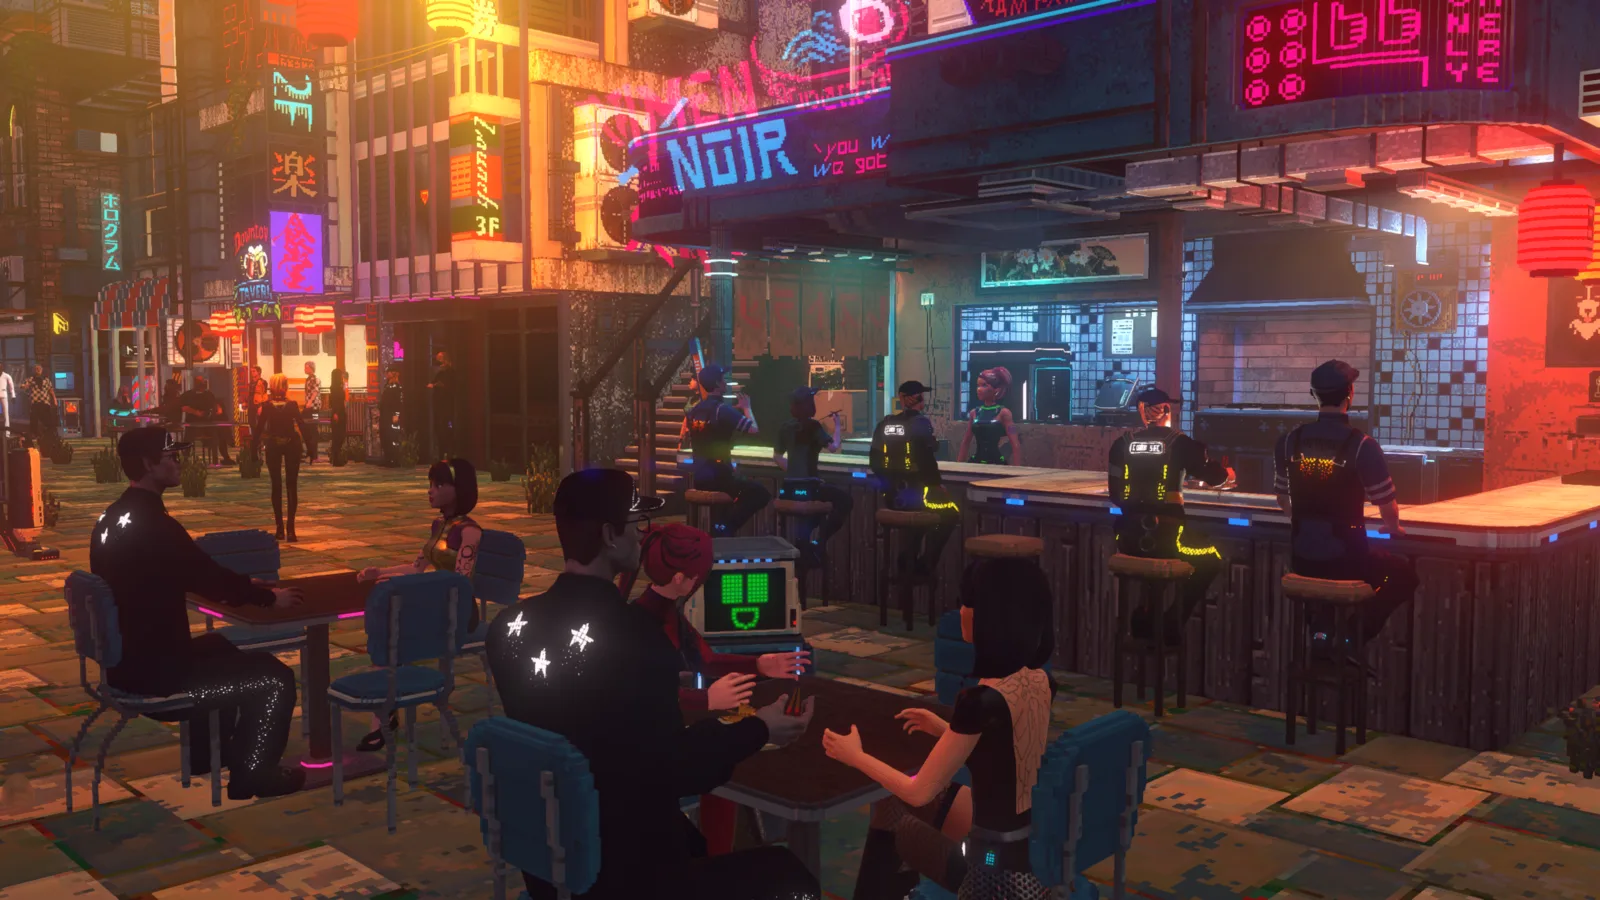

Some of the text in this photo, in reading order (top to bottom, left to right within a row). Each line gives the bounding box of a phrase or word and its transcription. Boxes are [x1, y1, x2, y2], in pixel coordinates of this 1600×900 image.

[1446, 0, 1470, 83] NLY
[1477, 0, 1502, 83] ERE
[272, 150, 318, 198] 楽
[855, 153, 887, 174] got
[103, 193, 121, 271] ホログラム
[475, 215, 500, 238] 3F
